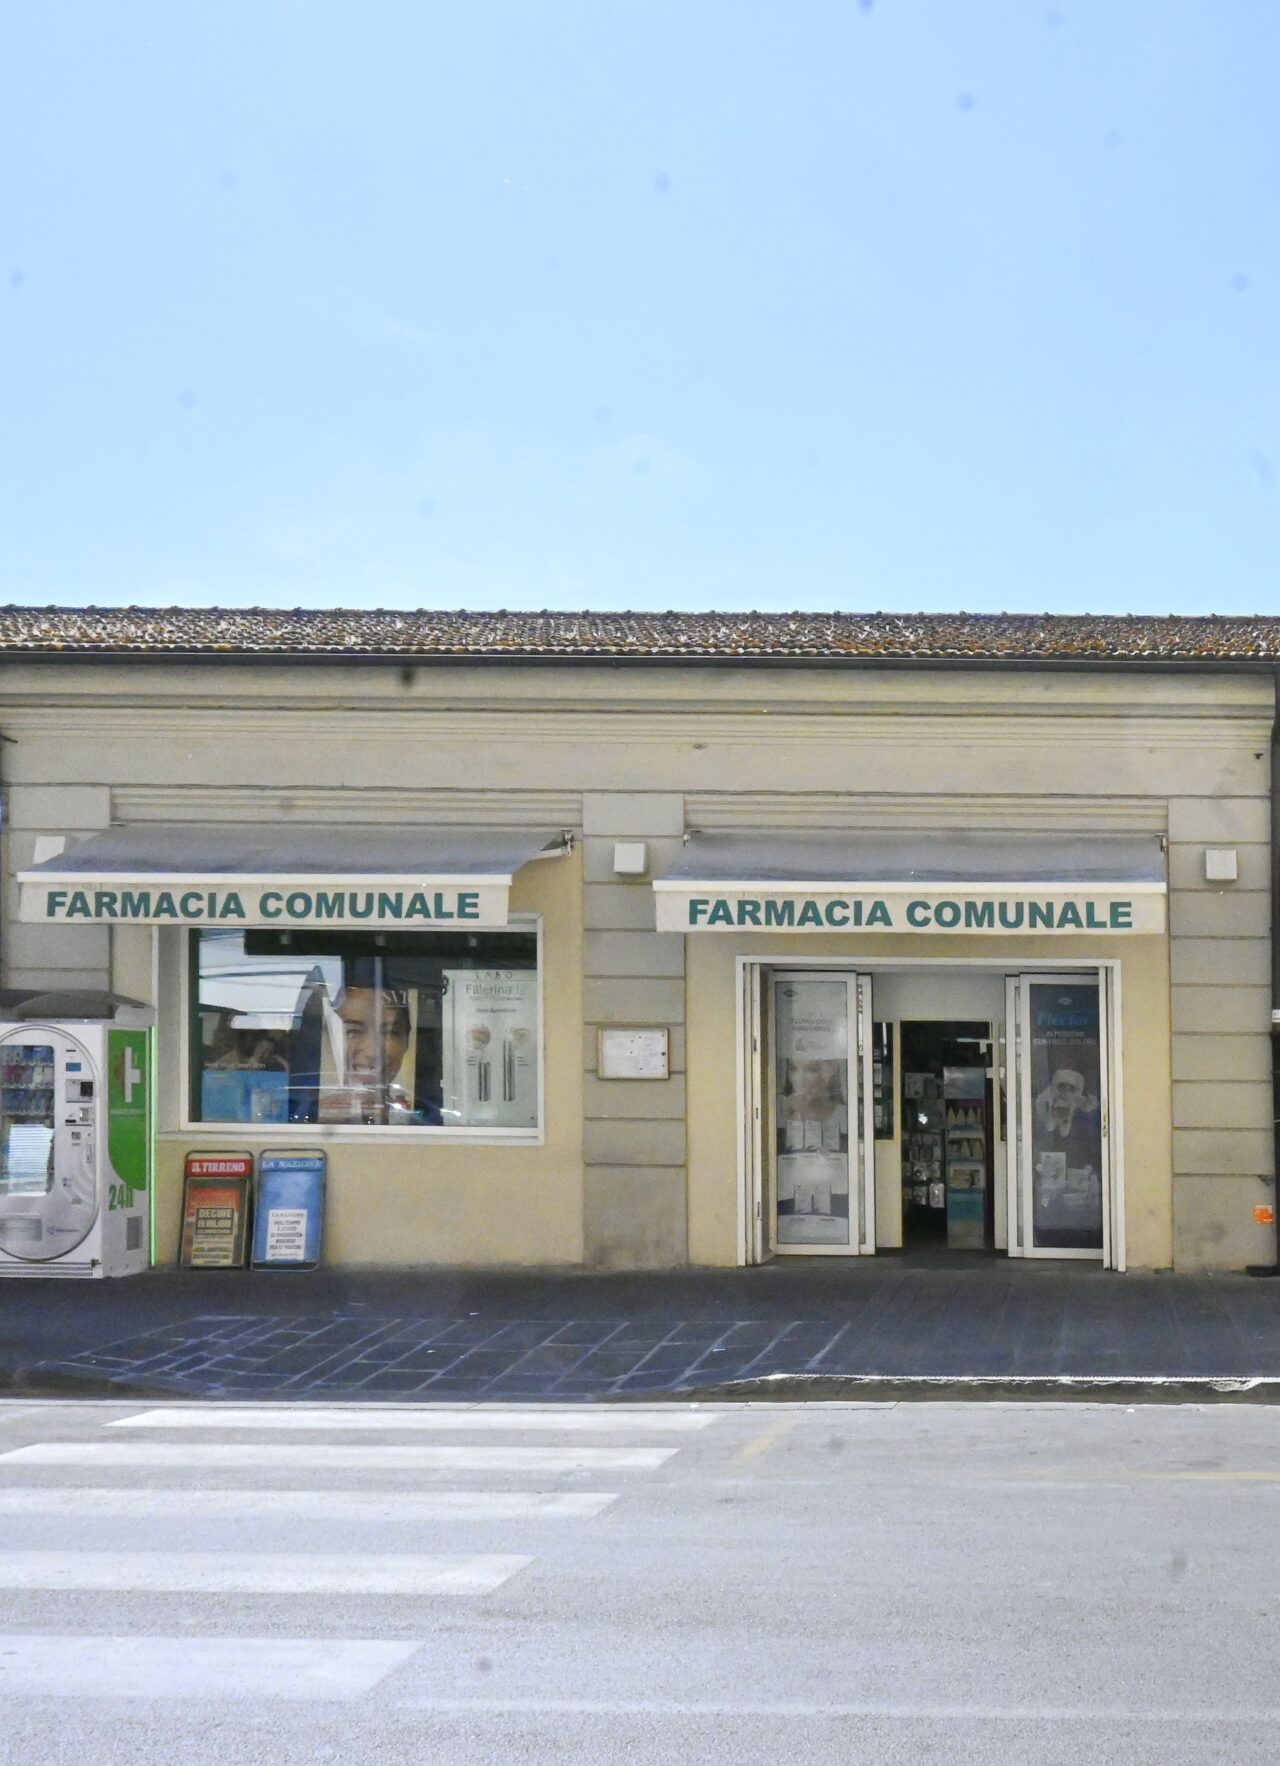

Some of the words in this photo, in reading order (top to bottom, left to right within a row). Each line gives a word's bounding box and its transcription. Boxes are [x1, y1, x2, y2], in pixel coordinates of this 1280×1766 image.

[47, 891, 245, 918] FARMACIA
[260, 891, 479, 919] COMUNALE
[689, 899, 892, 926] FARMACIA
[907, 901, 1132, 929] COMUNALE
[466, 984, 511, 995] Fillerina
[192, 1162, 200, 1172] IL
[201, 1162, 245, 1172] TIRRENO
[279, 1160, 322, 1168] NAZIONE
[108, 1184, 134, 1211] 24h
